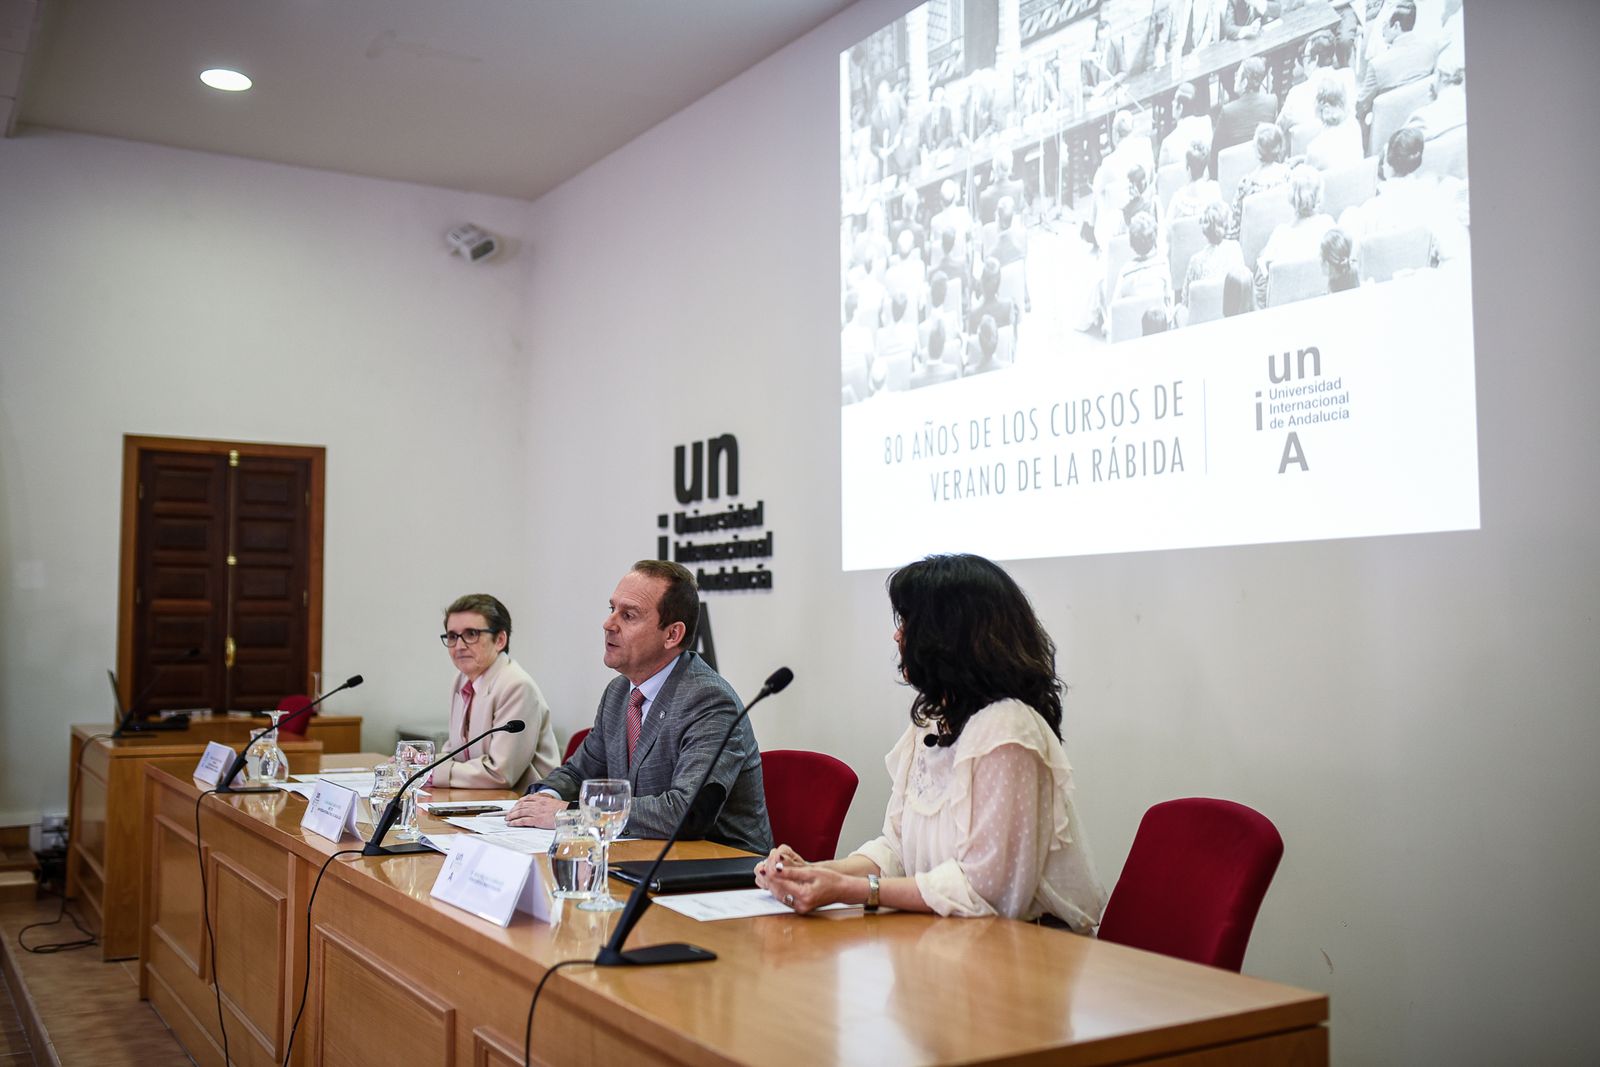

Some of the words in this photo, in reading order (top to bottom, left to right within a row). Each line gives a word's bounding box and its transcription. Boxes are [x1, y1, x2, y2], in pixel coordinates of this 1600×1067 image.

[1268, 346, 1320, 384] un
[1269, 377, 1342, 400] Universidad
[1269, 391, 1350, 415] Internacional
[885, 434, 903, 465] 80
[912, 420, 960, 461] AÑOS
[970, 417, 991, 450] DE
[1003, 408, 1038, 445] LOS
[1051, 388, 1140, 437] CURSOS
[1154, 380, 1184, 420] DE
[1269, 417, 1285, 429] de
[1288, 407, 1350, 427] Andalucía
[674, 433, 739, 504] un
[930, 462, 1006, 502] VERANO
[1018, 457, 1042, 491] DE
[1054, 452, 1079, 487] LA
[1092, 436, 1185, 483] RÁBIDA
[1278, 431, 1309, 474] A
